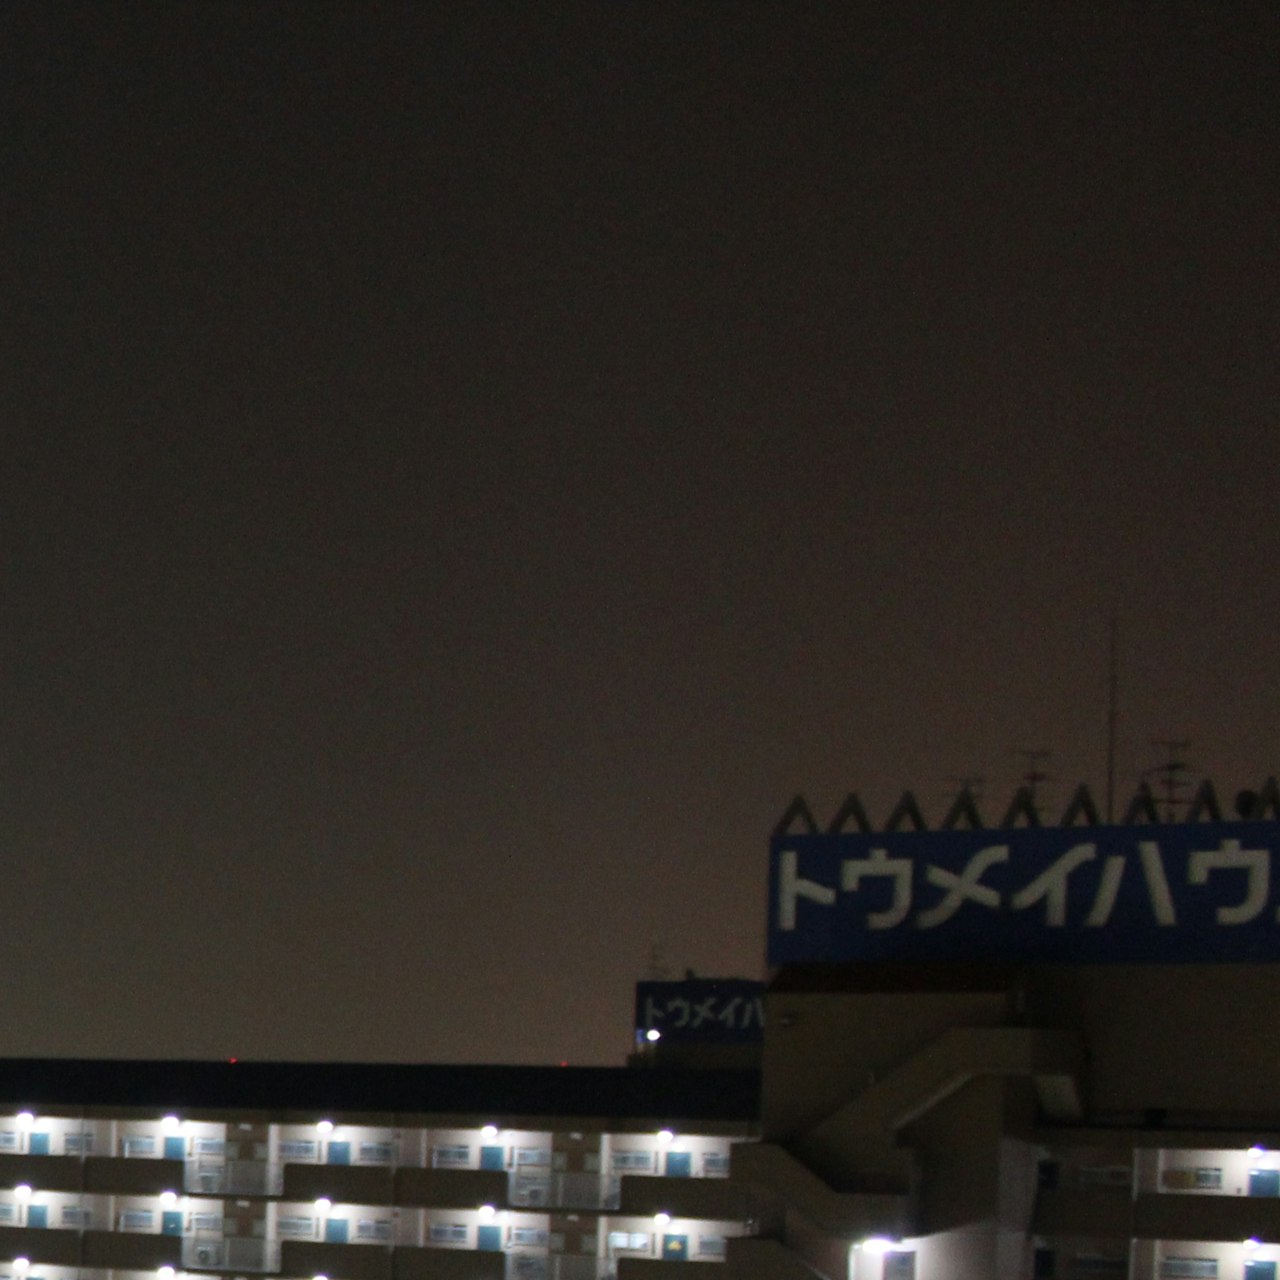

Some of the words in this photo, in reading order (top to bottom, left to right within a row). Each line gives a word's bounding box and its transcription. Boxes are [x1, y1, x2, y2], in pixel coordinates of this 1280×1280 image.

[780, 840, 1280, 931] トウメイハウ
